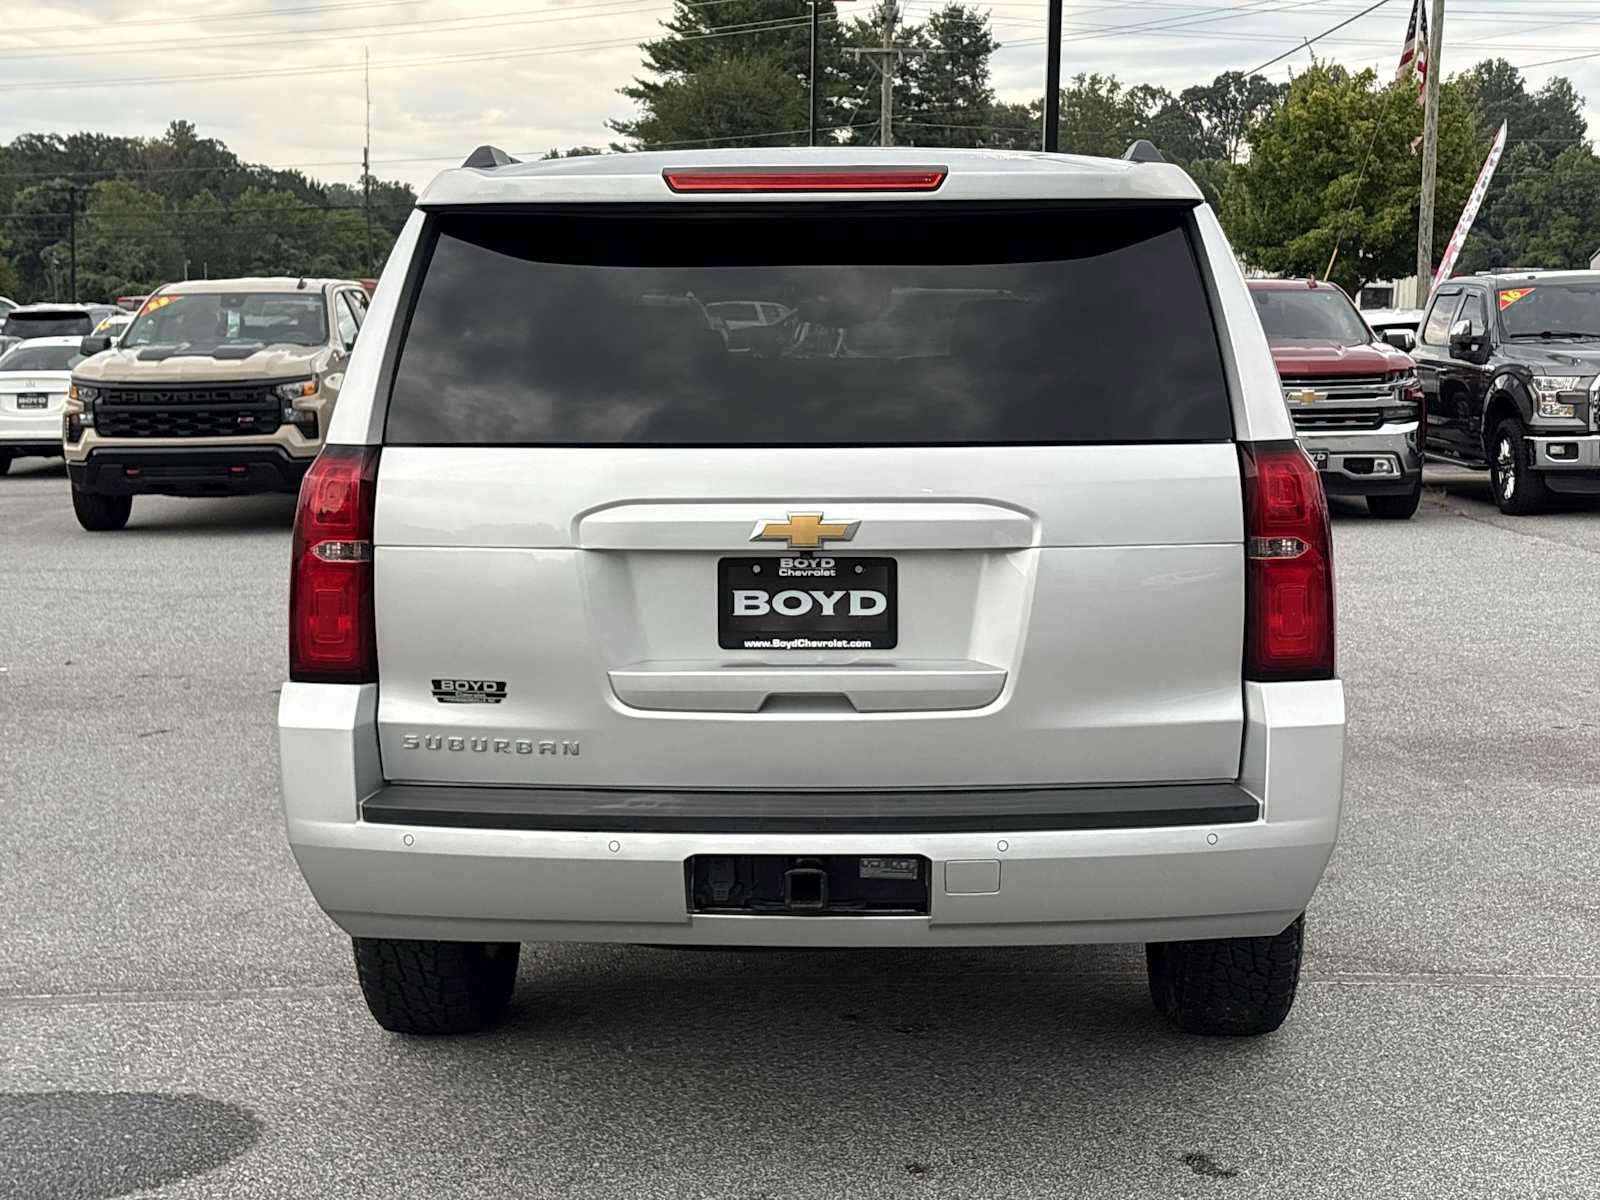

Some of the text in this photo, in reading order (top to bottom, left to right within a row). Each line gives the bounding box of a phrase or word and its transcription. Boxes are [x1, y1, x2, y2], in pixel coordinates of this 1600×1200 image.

[780, 558, 835, 568] BOYD
[778, 568, 837, 577] Chevrolet
[732, 590, 887, 616] BOYD
[743, 638, 872, 649] www.BoydChevrolet.com
[441, 680, 498, 692] BOYD
[402, 733, 580, 756] SUBURBAN
